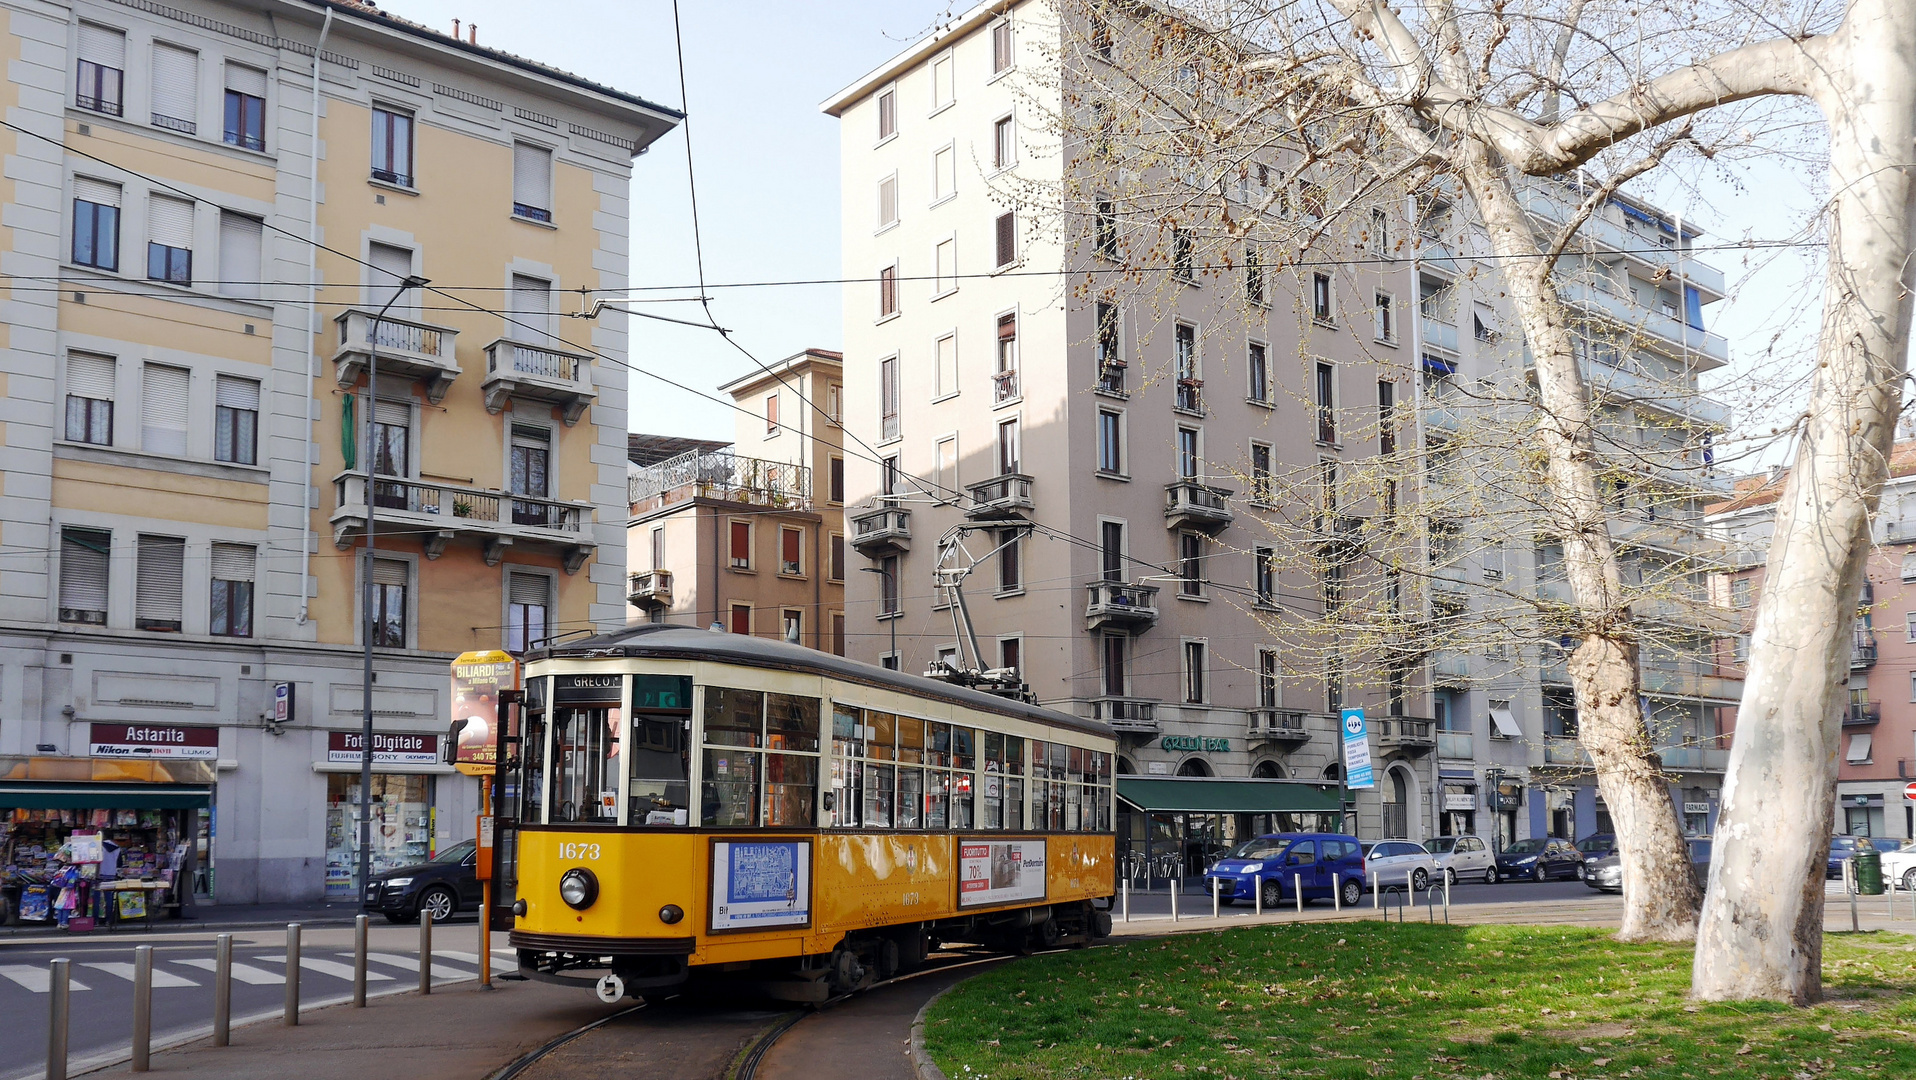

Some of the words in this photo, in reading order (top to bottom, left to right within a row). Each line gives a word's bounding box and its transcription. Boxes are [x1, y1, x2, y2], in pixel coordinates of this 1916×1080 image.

[456, 664, 495, 678] BILIARDI
[488, 677, 498, 685] City
[574, 676, 610, 687] GRECO
[125, 726, 185, 742] Astarita
[344, 734, 363, 748] Fot
[373, 734, 423, 752] Digitale
[1162, 735, 1203, 753] GREEN
[1206, 737, 1231, 752] BAR
[96, 745, 130, 755] Nikon
[330, 752, 361, 760] FUJIFILM
[607, 797, 611, 805] 3
[608, 807, 612, 815] 1
[559, 842, 600, 860] 1673
[963, 847, 987, 857] FUORITUTTO
[969, 865, 982, 879] 70%
[902, 892, 919, 906] 1673
